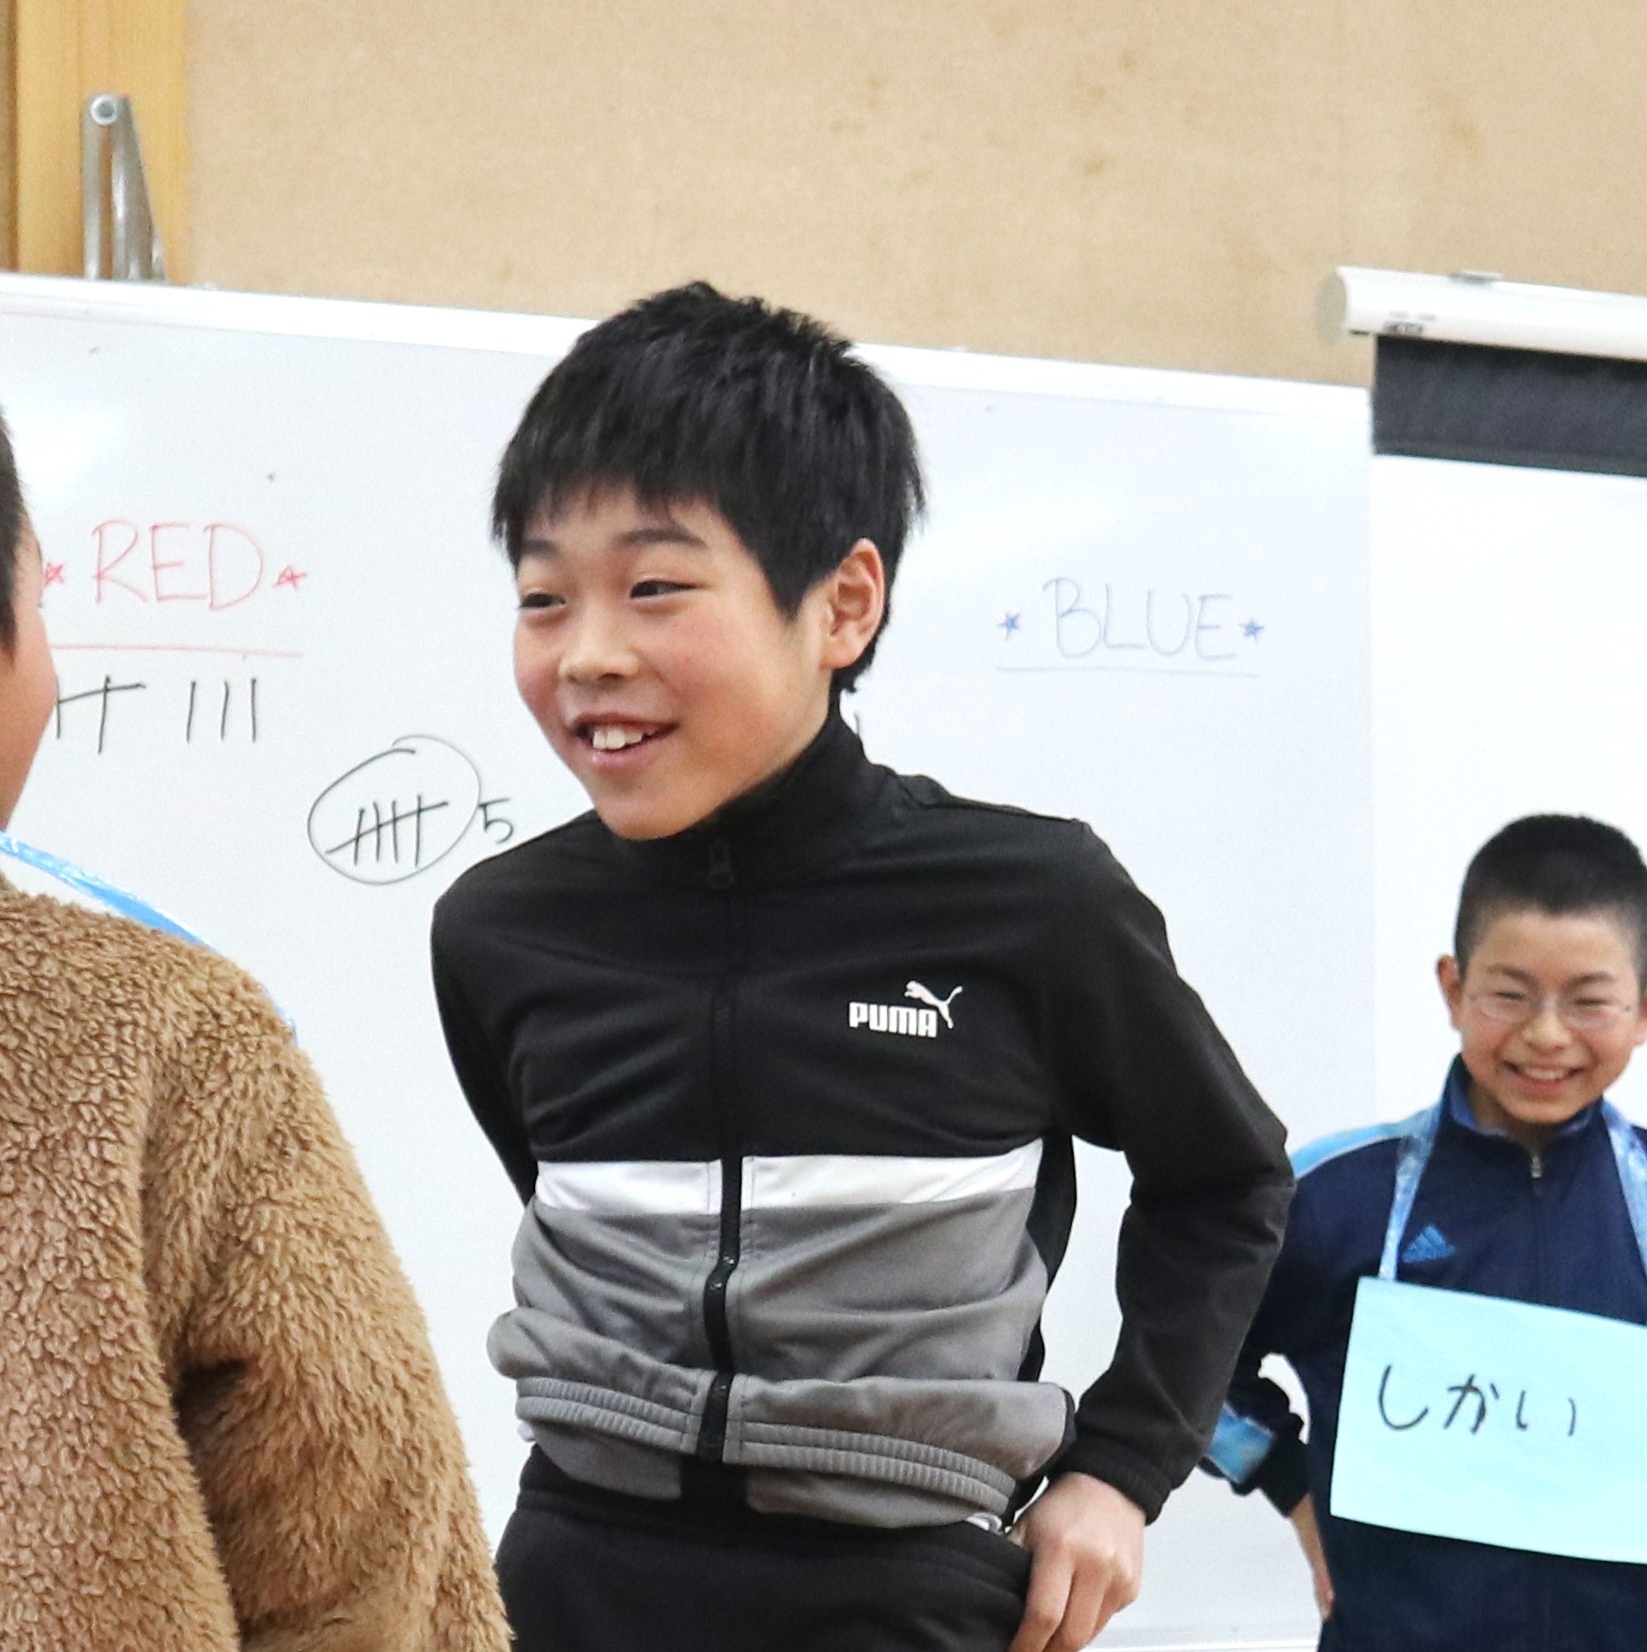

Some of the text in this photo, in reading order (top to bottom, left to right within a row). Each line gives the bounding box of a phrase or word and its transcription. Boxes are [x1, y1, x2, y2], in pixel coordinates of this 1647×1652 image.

[91, 518, 265, 612] RED
[1042, 577, 1238, 661] BLUE
[478, 797, 515, 844] 5
[849, 1001, 939, 1038] PUMA
[1377, 1363, 1579, 1437] しかい
